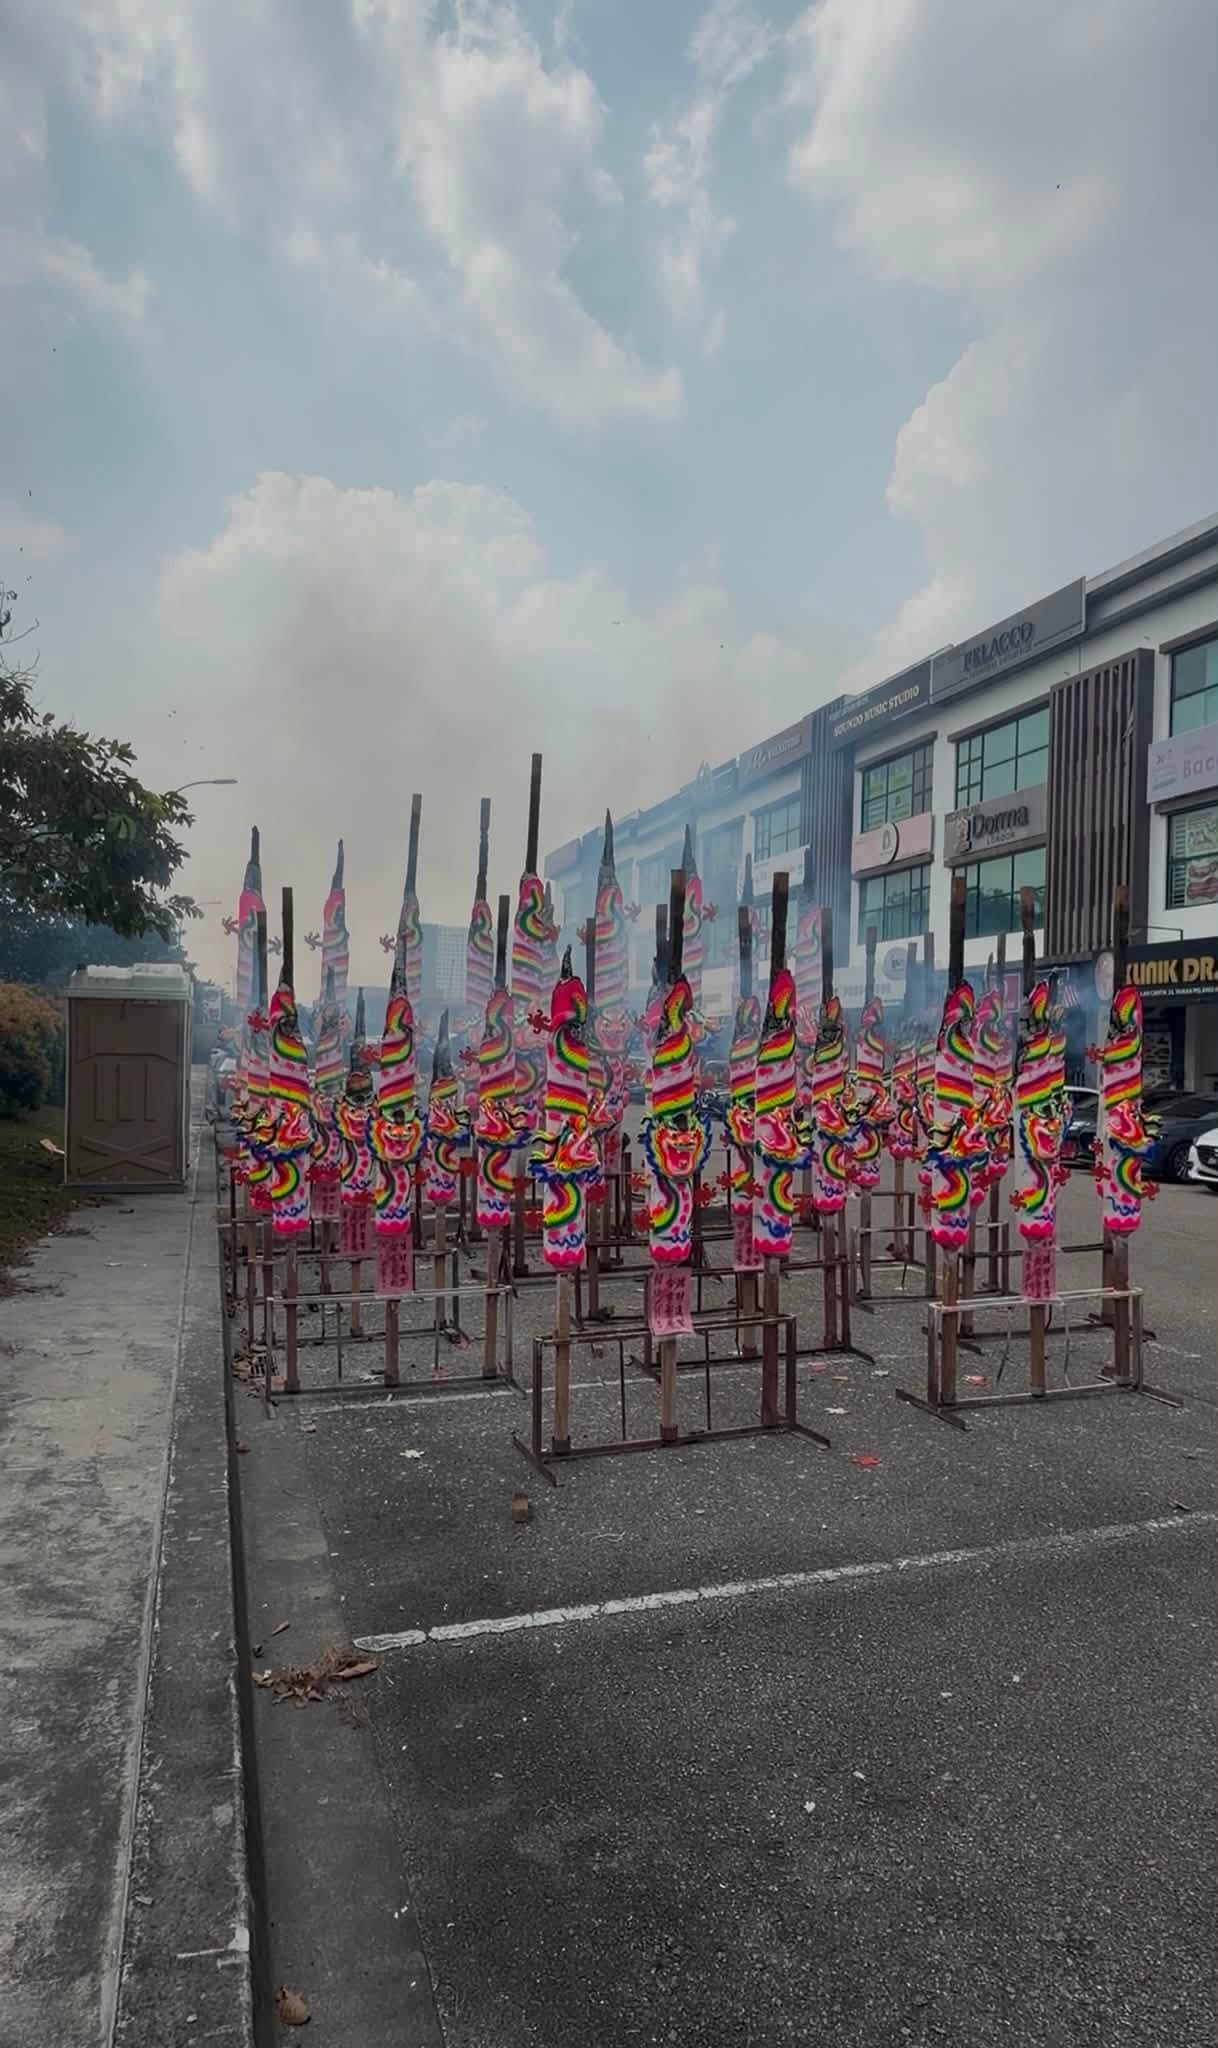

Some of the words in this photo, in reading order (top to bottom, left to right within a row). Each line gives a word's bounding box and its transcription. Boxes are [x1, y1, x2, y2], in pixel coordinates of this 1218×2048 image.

[863, 701, 888, 723] MUSIC
[888, 685, 920, 713] STUDIO
[1184, 757, 1218, 780] Bac
[972, 806, 1029, 840] Dorma
